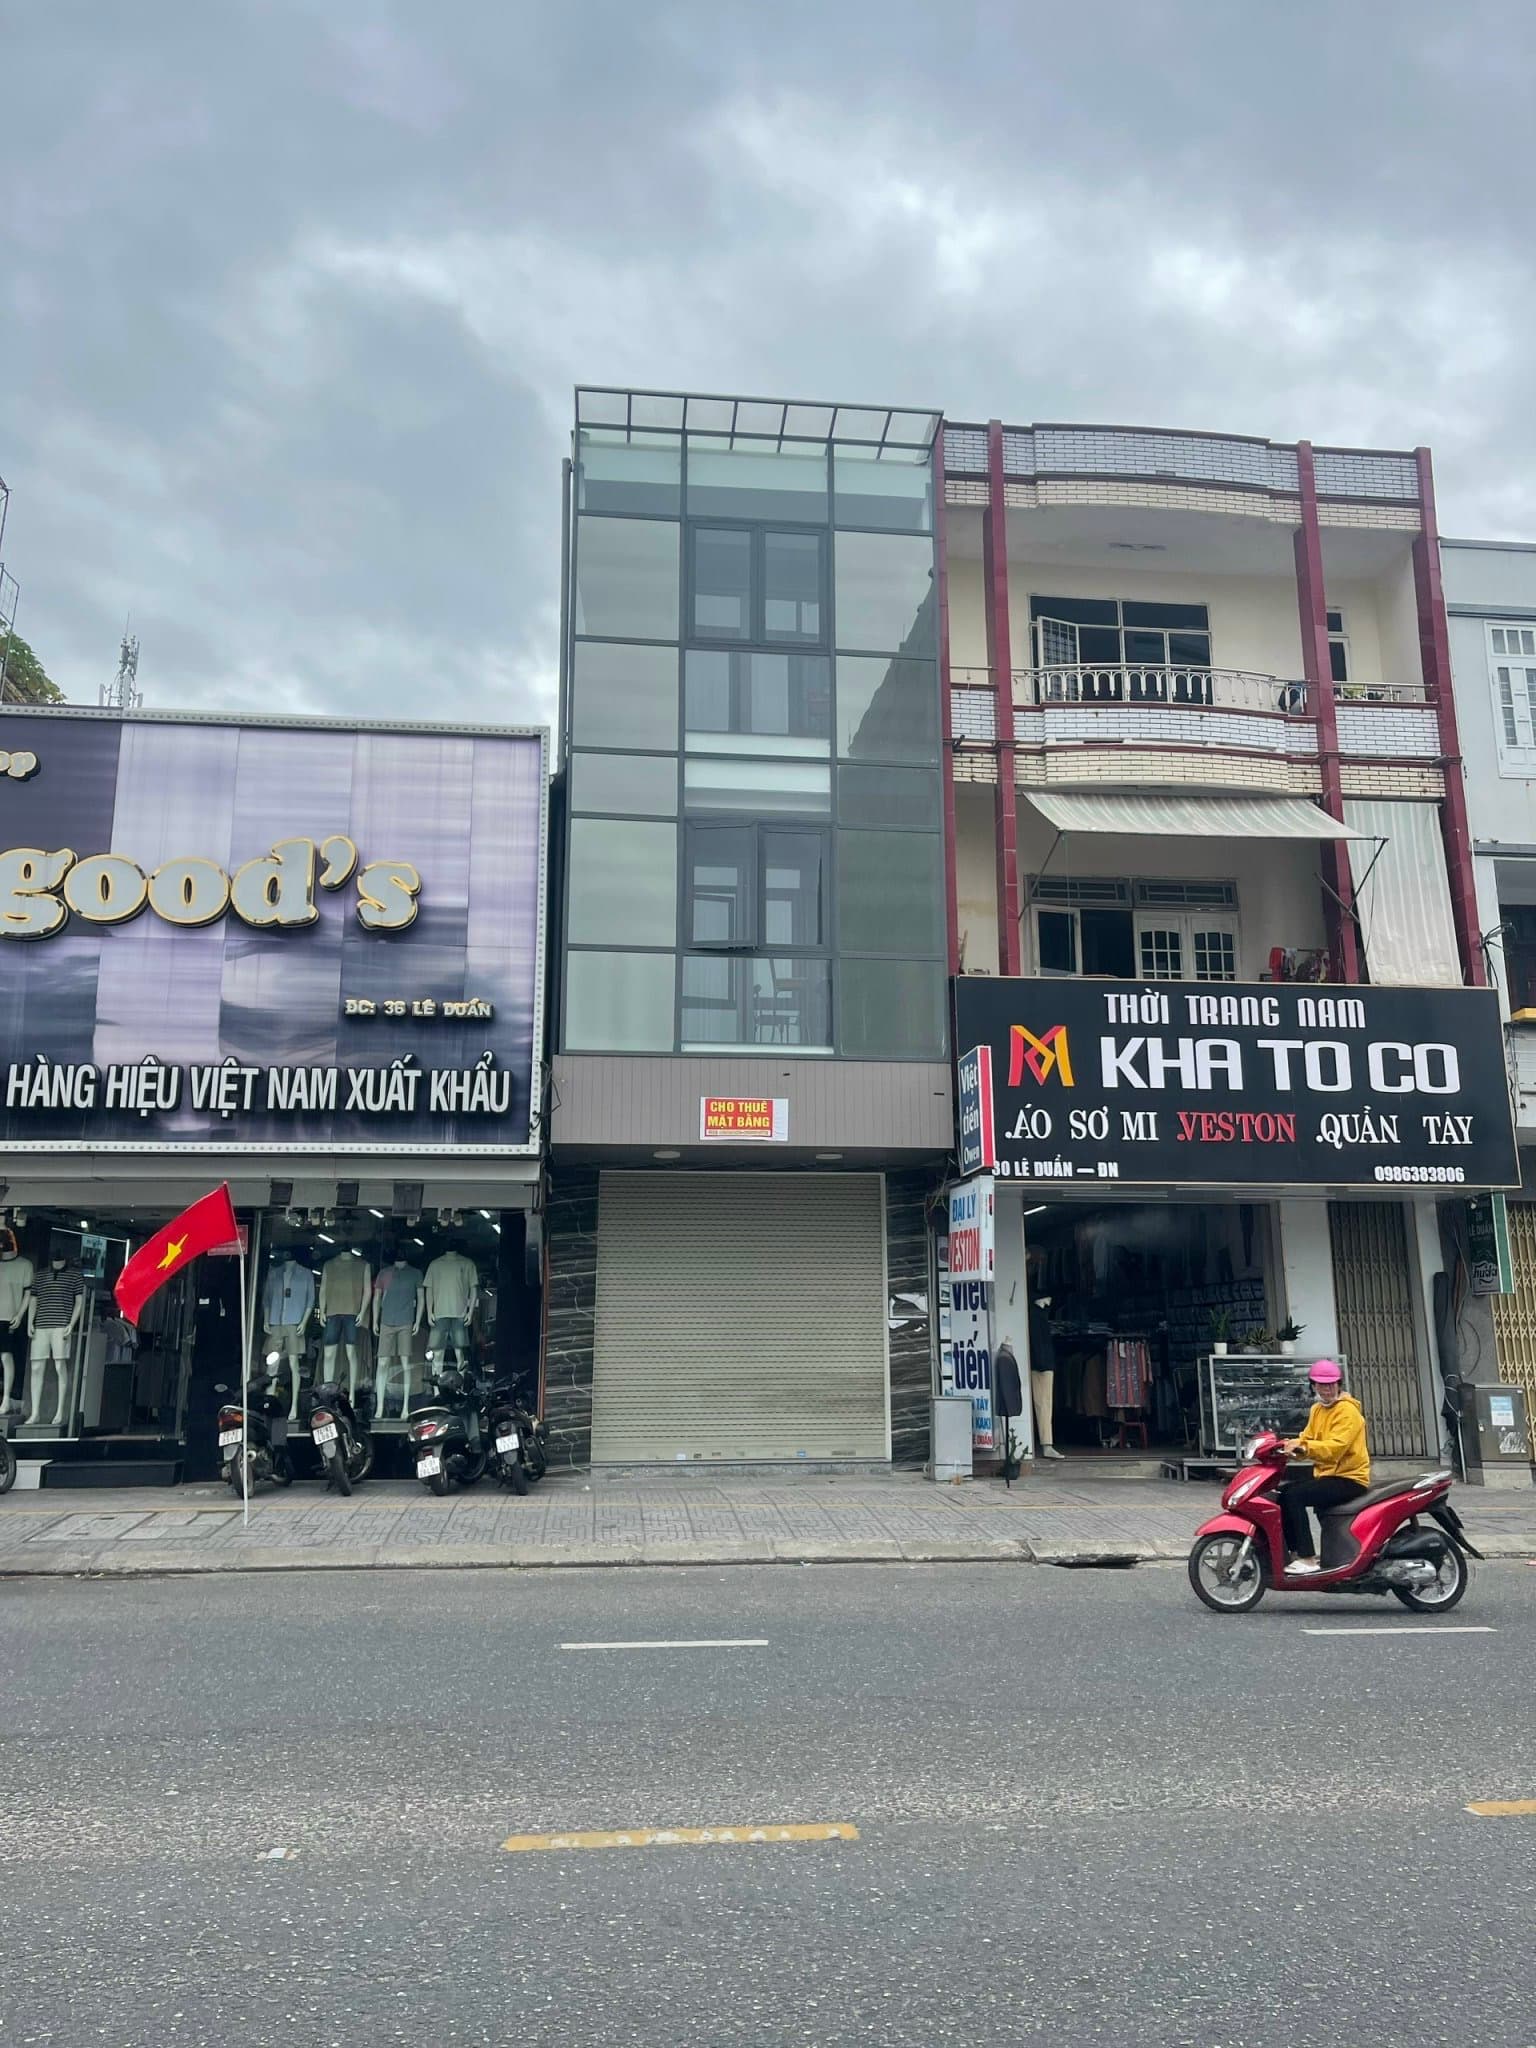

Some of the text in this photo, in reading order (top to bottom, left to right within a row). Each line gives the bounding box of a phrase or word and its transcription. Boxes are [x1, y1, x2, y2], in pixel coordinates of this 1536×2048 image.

[384, 1000, 406, 1016] 36
[412, 999, 436, 1016] LÊ
[1104, 988, 1366, 1028] THỜI TRANG NAM
[1101, 1036, 1461, 1094] KHA TO CO
[7, 1050, 510, 1119] HÀNG HIỆU VIỆT NAM XUẤT KHẨU
[707, 1114, 734, 1129] MẶT
[710, 1100, 768, 1113] CHO THUÊ
[1069, 1106, 1110, 1141] SƠ
[1120, 1111, 1160, 1141] MI
[1014, 1157, 1030, 1177] LÊ
[1034, 1154, 1073, 1177] DUẨN
[1374, 1166, 1465, 1182] 0986383806
[949, 1226, 979, 1273] VESTON
[953, 1331, 990, 1390] tiến
